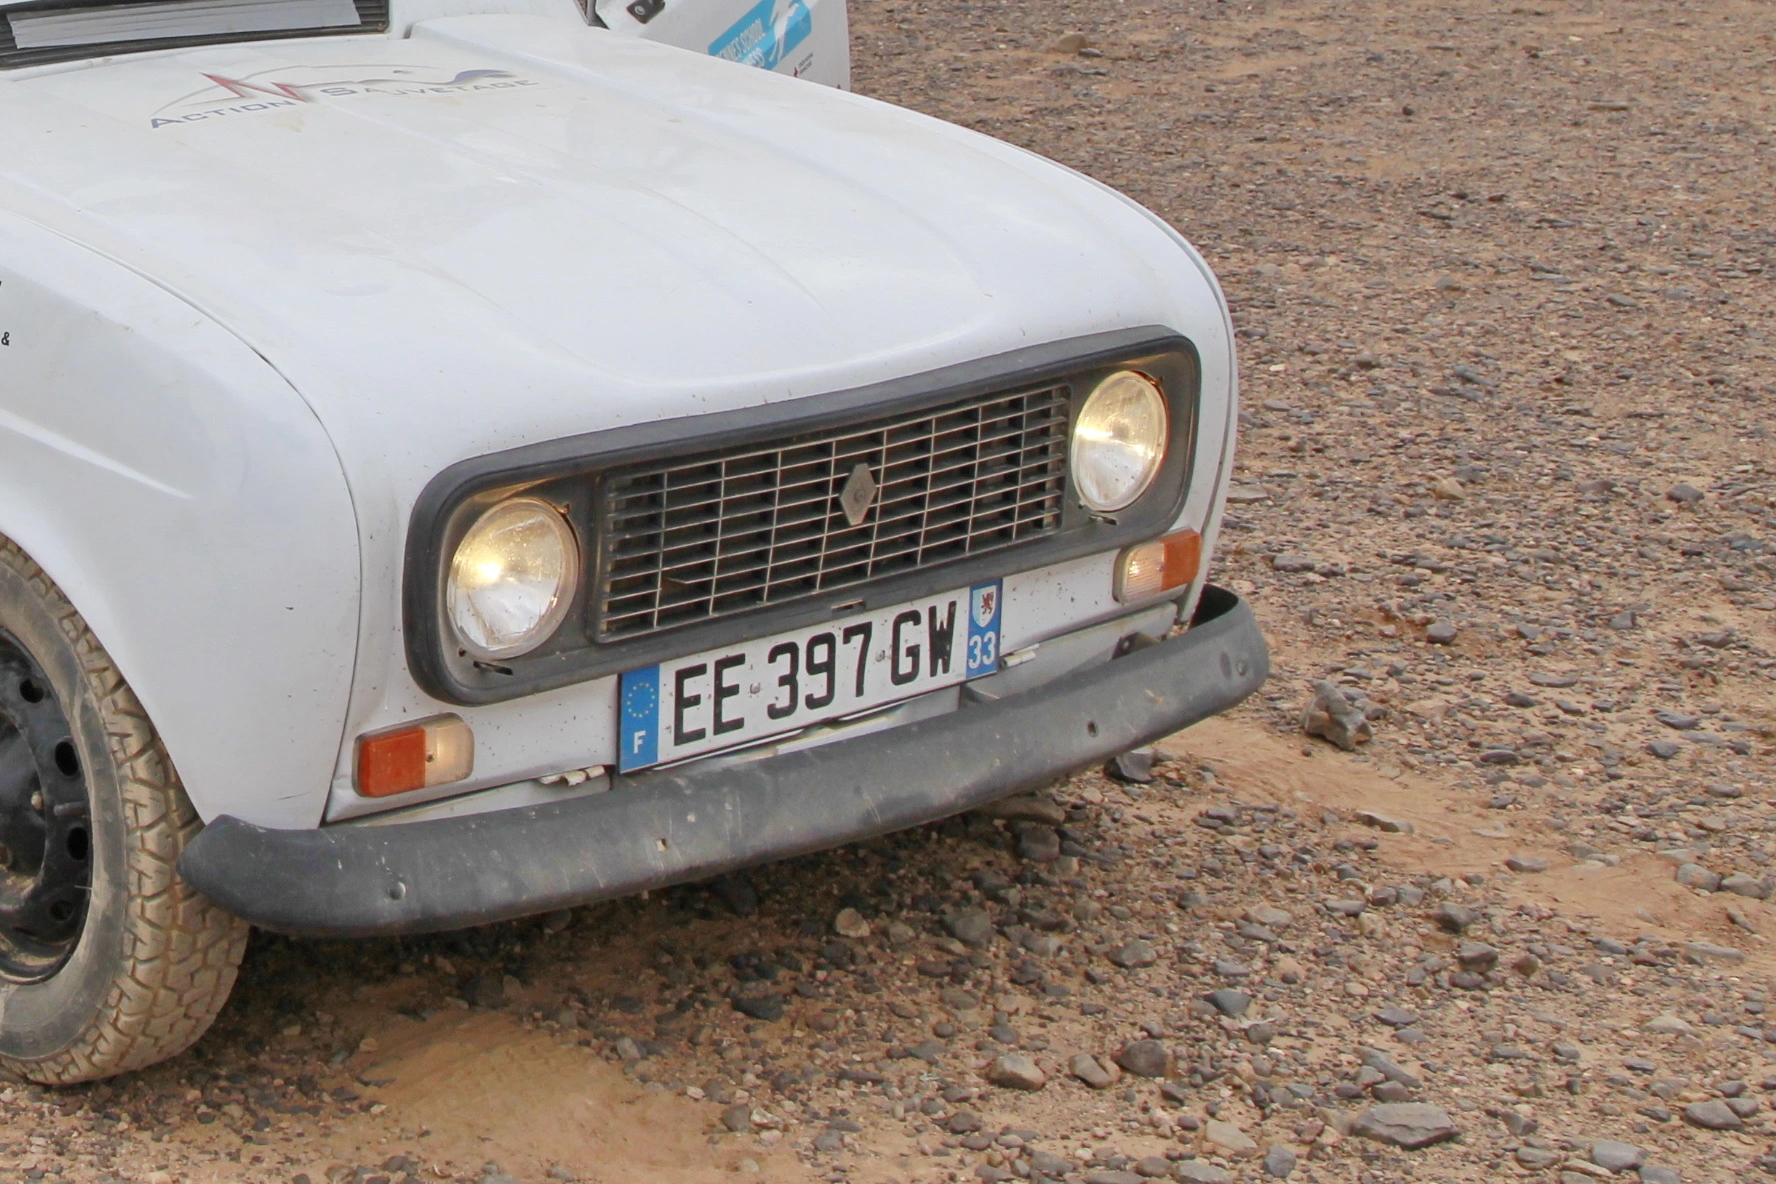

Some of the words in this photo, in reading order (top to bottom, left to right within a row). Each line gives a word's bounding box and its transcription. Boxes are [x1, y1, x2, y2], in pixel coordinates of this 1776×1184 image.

[967, 631, 997, 670] 33
[673, 652, 746, 746] EE
[766, 621, 873, 720] 397
[890, 600, 958, 686] GW
[633, 730, 647, 754] F
